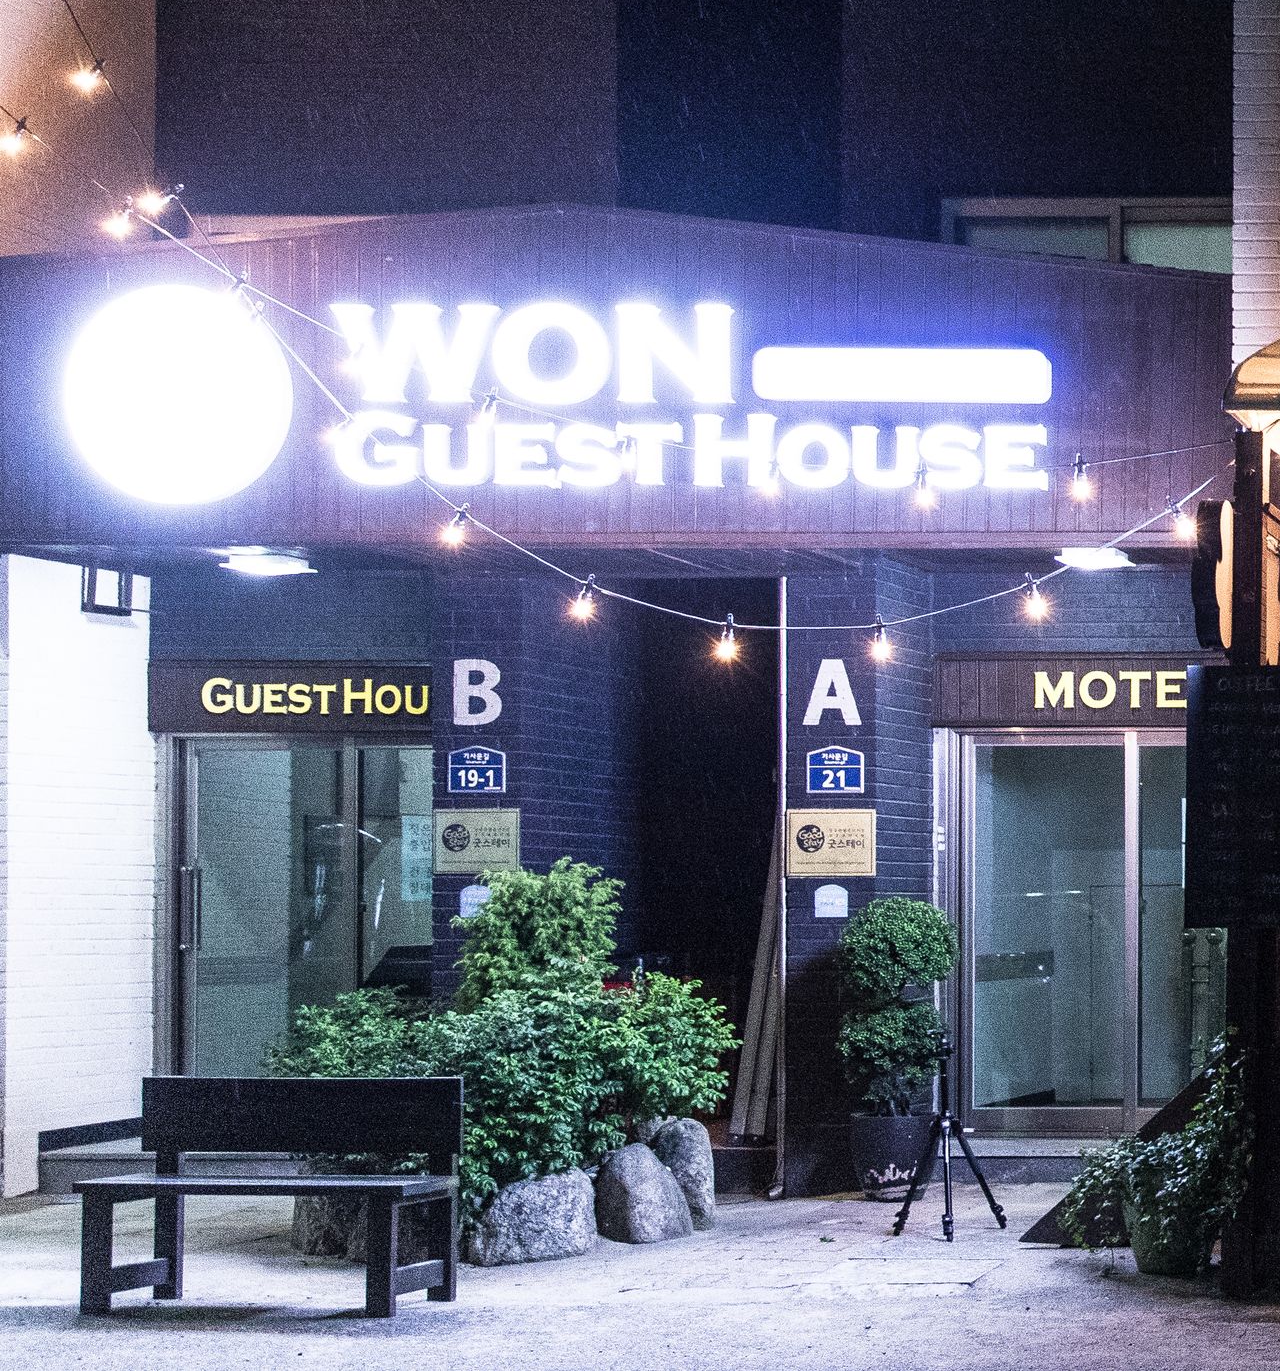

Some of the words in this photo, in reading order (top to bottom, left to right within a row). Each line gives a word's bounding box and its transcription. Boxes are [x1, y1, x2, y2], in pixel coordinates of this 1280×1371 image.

[329, 302, 736, 405] WON
[452, 659, 503, 726] B
[802, 659, 862, 725] A
[458, 769, 495, 788] 19-1
[822, 769, 846, 788] 21
[798, 829, 824, 840] Good
[827, 838, 865, 849] 굿스테이
